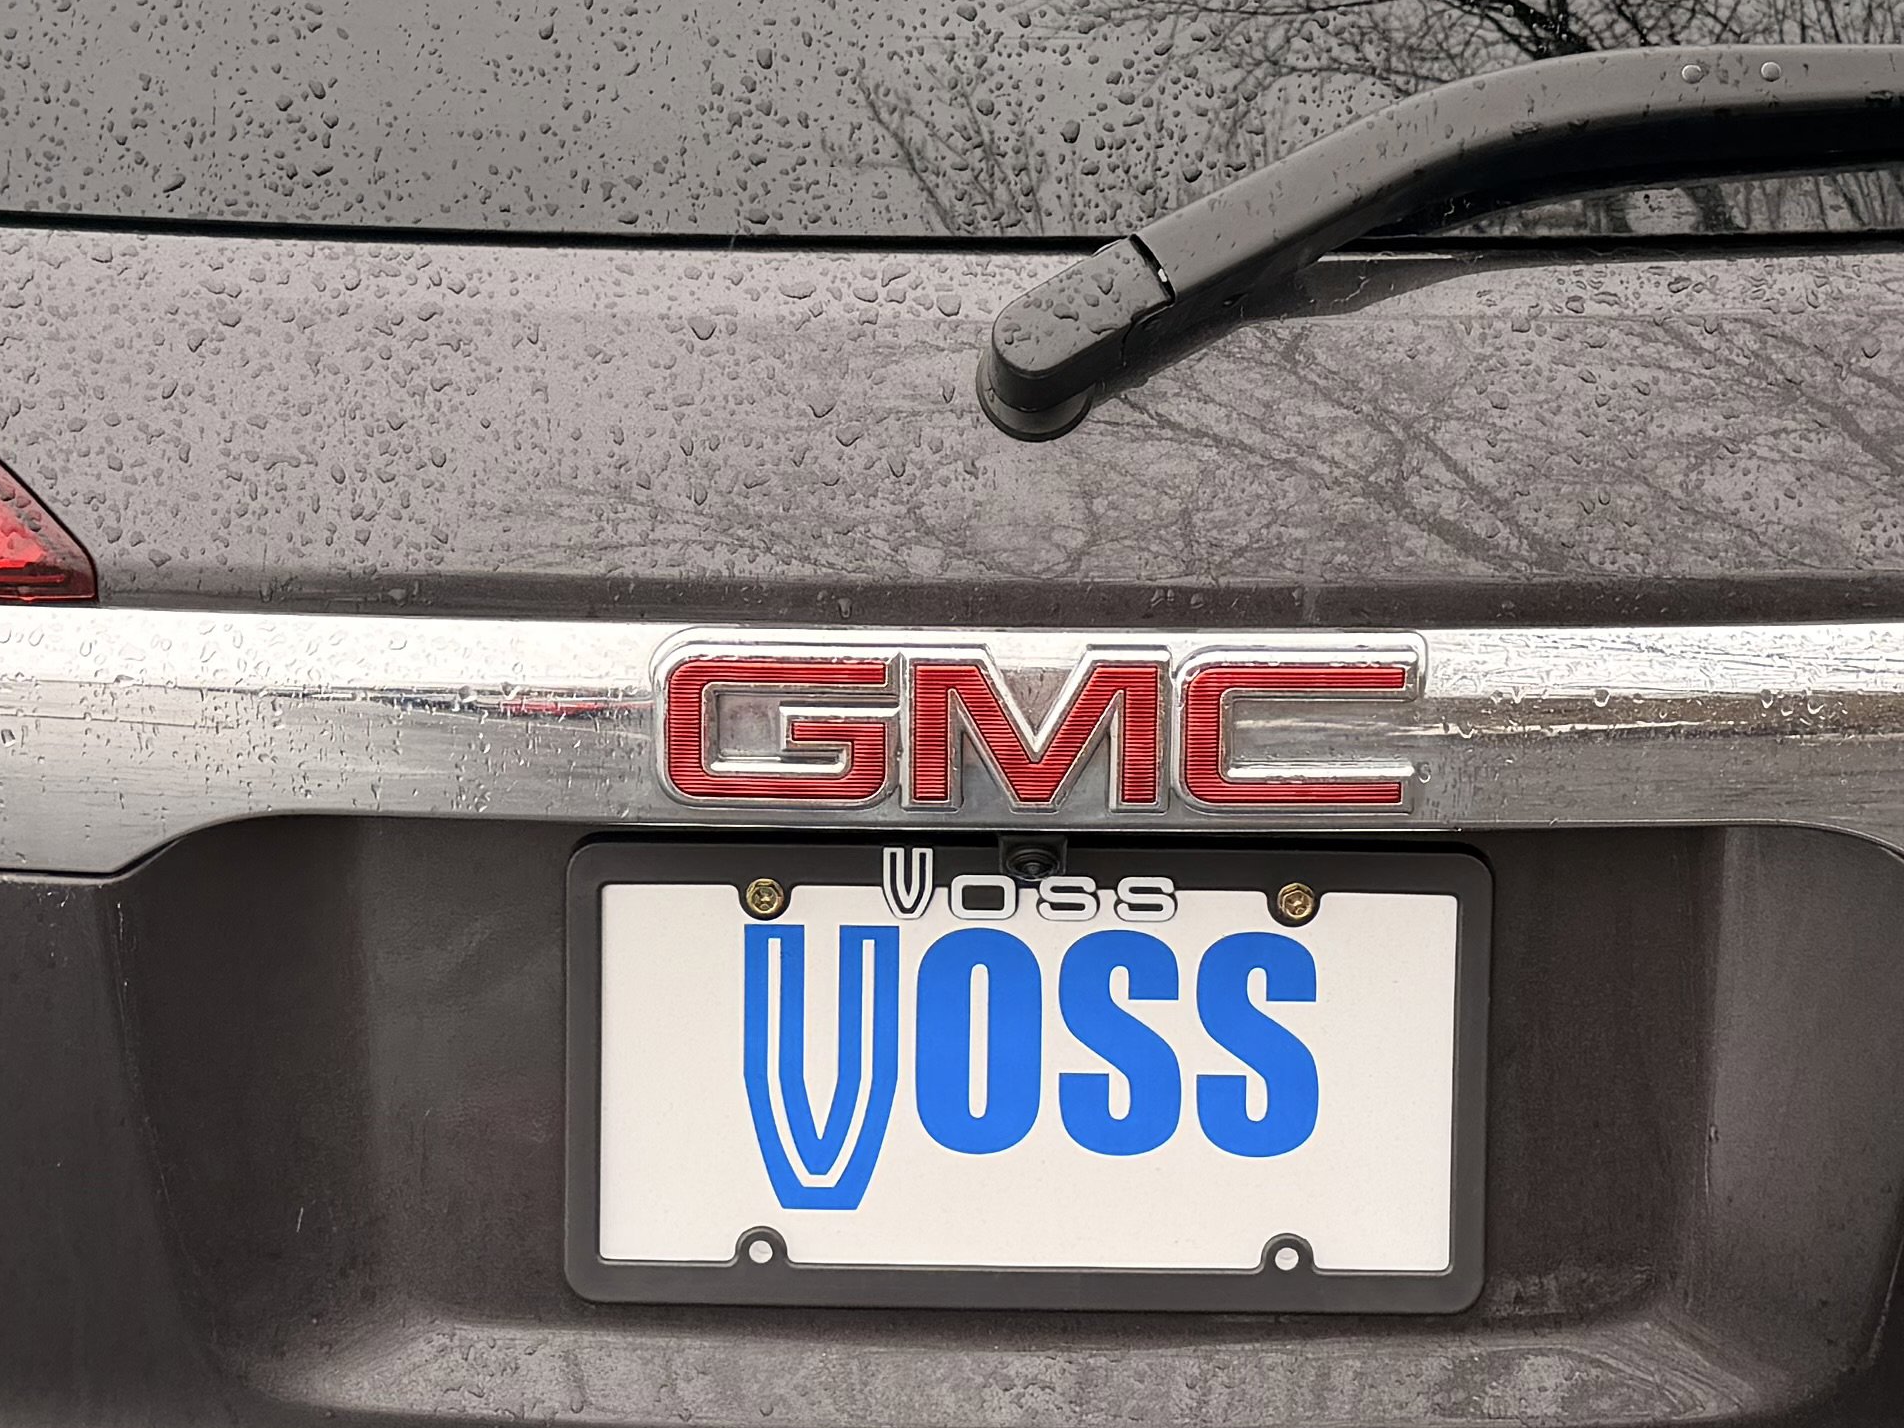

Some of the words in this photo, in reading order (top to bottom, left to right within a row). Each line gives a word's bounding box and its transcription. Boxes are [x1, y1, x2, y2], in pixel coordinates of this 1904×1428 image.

[659, 640, 1420, 813] GMC
[882, 846, 1177, 922] VOSS
[743, 924, 1319, 1210] VOSS
